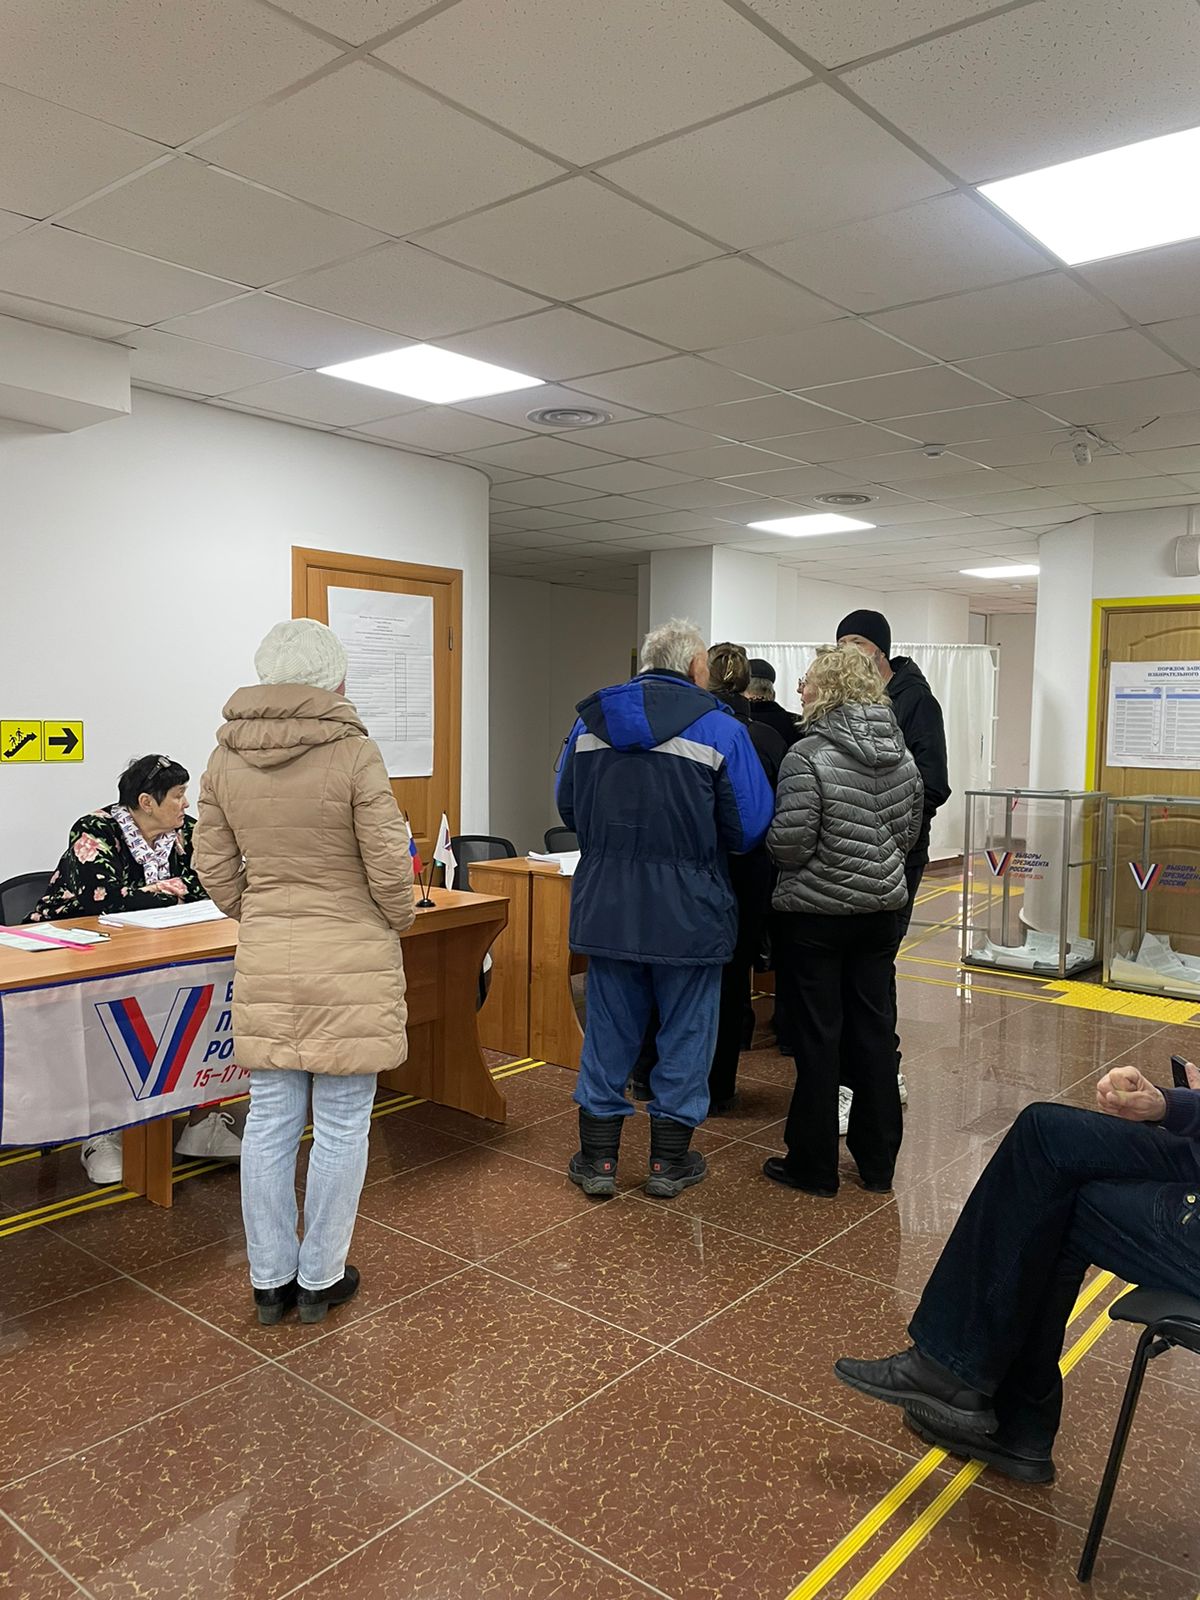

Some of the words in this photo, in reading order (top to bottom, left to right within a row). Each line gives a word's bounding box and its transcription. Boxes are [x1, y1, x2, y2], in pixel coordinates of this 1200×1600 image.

[1015, 852, 1042, 860] ВЫБОРЫ
[1012, 859, 1049, 867] ПРЕЗИДЕНТА
[1162, 872, 1200, 880] ПРЕЗИДЕН
[203, 1038, 235, 1063] РО
